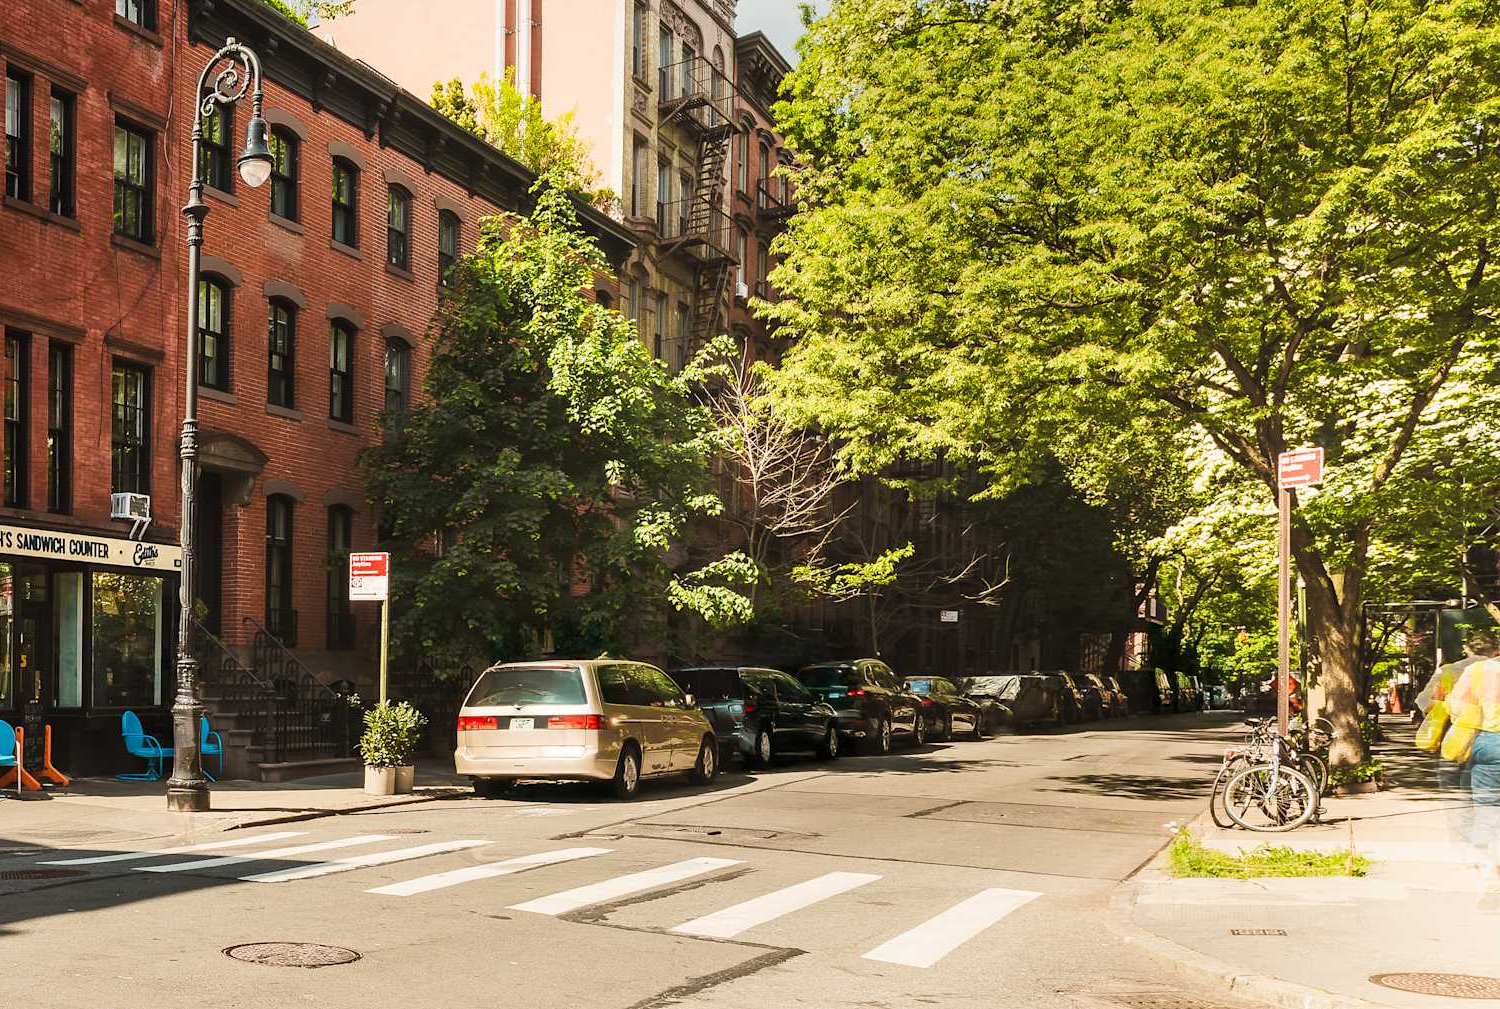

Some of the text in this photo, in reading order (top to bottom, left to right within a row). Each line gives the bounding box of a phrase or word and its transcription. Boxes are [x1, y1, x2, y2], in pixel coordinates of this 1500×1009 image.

[16, 532, 66, 554] SANDWICH
[69, 539, 109, 559] COUNTER
[133, 543, 159, 566] Edith's
